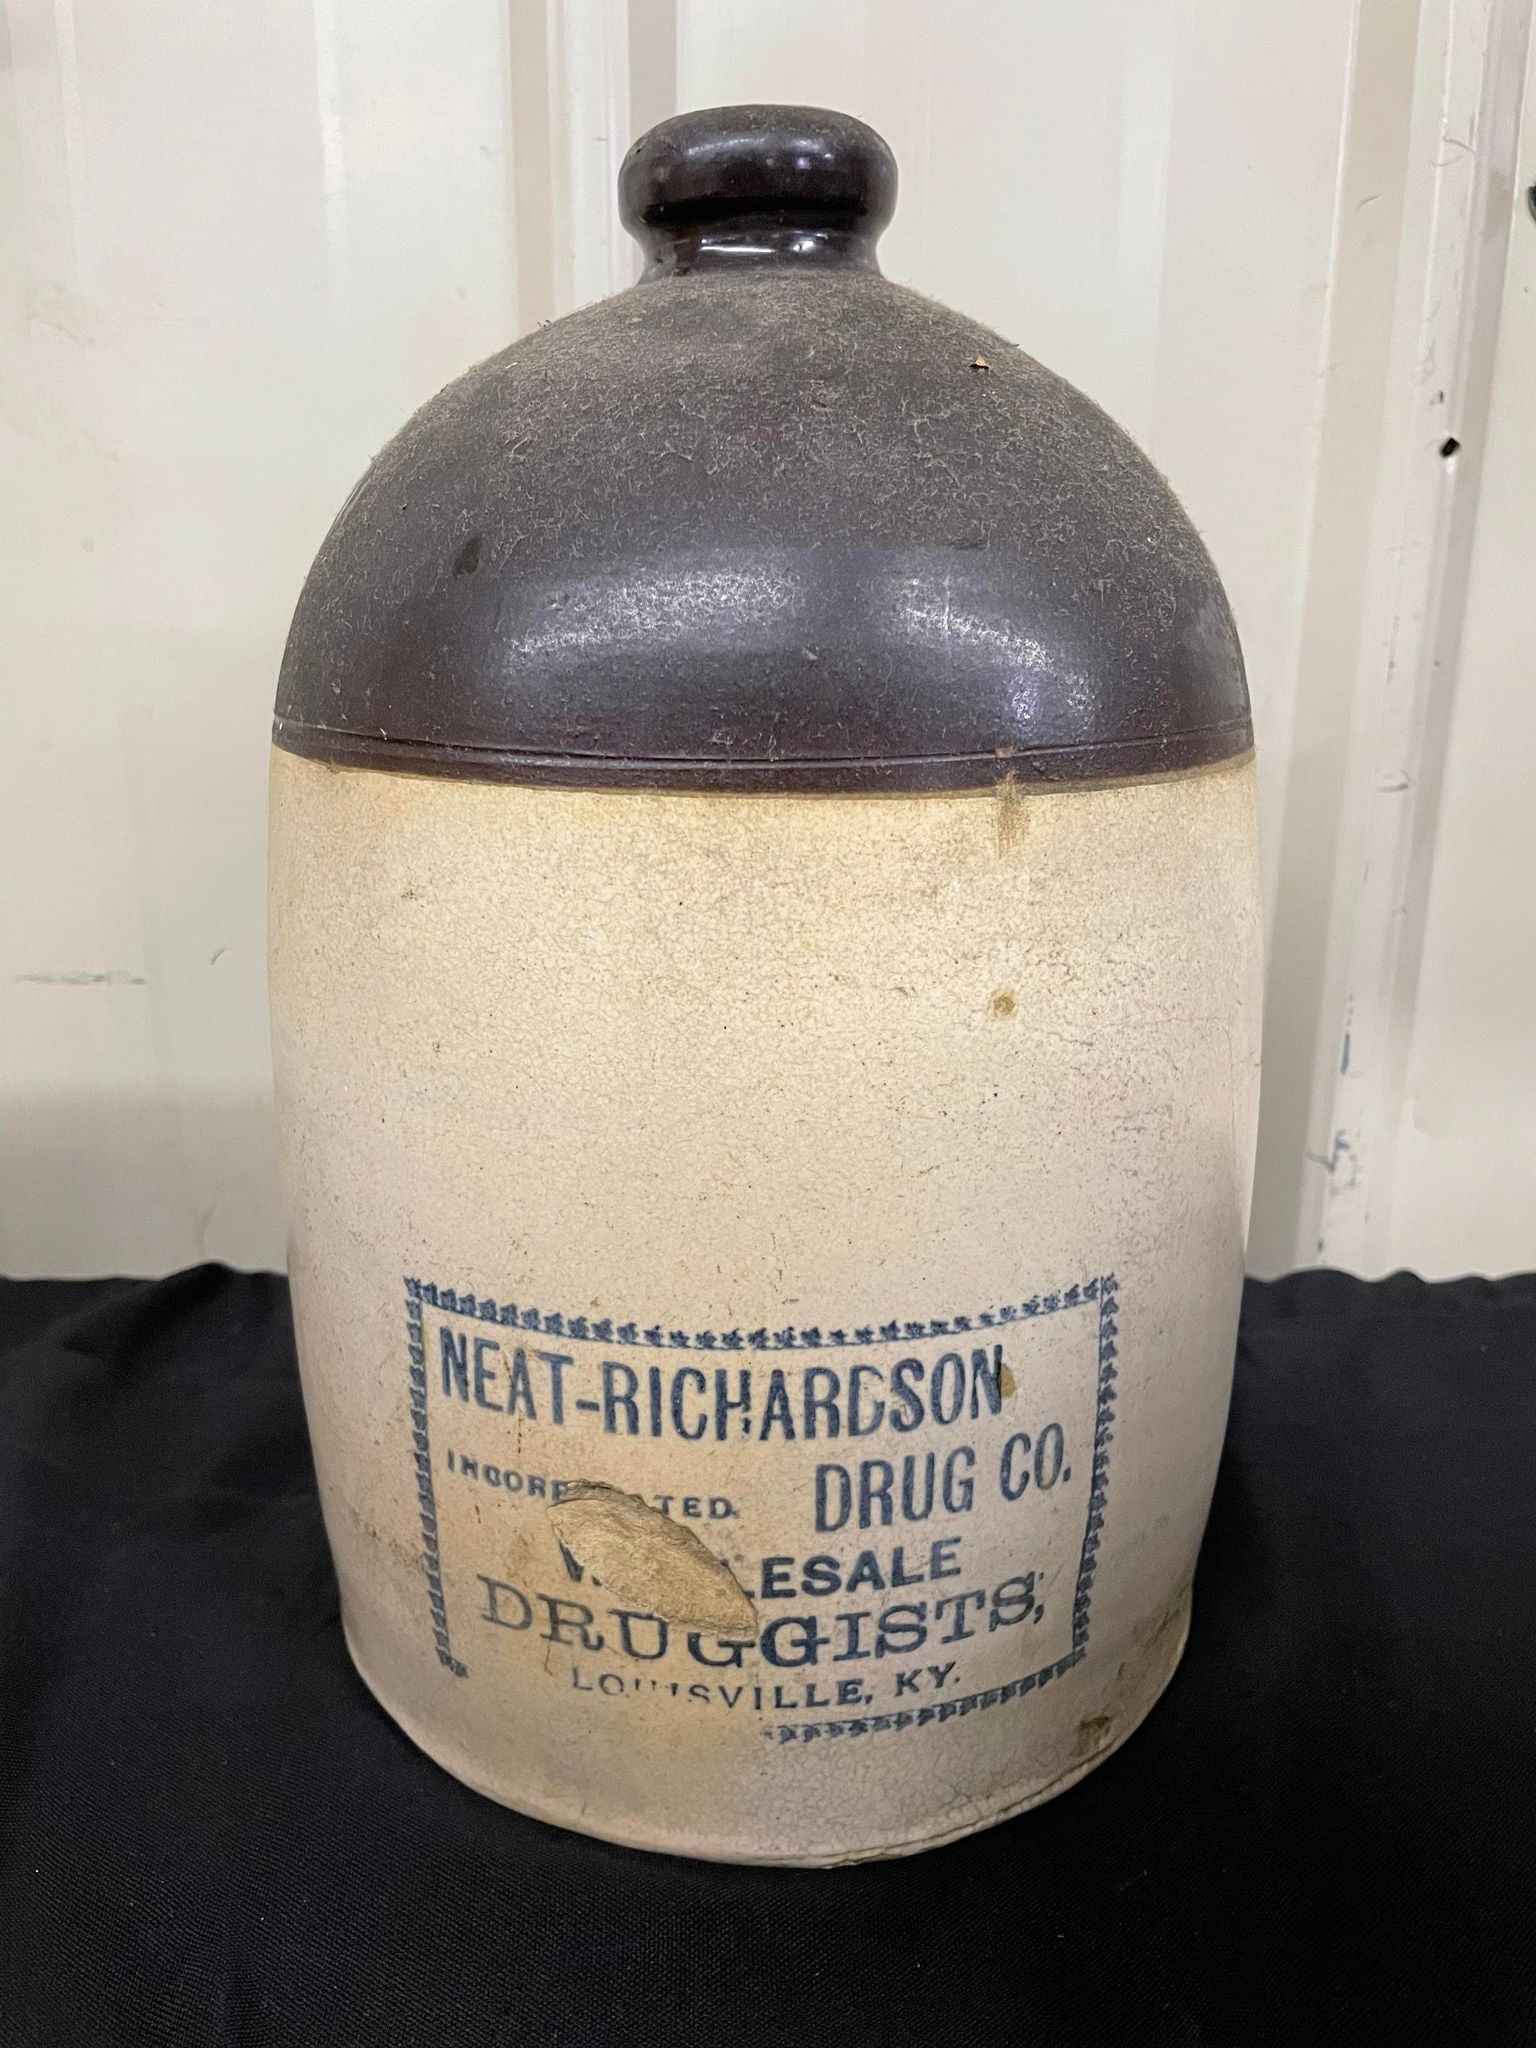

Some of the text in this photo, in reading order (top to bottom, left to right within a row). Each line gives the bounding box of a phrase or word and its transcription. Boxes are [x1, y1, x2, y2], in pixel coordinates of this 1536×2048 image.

[440, 1326, 1003, 1441] NEAT-RICHARDSON
[447, 1448, 744, 1519] INCORPTED.
[814, 1422, 1071, 1533] DRUG CO.
[894, 1661, 961, 1697] KY.
